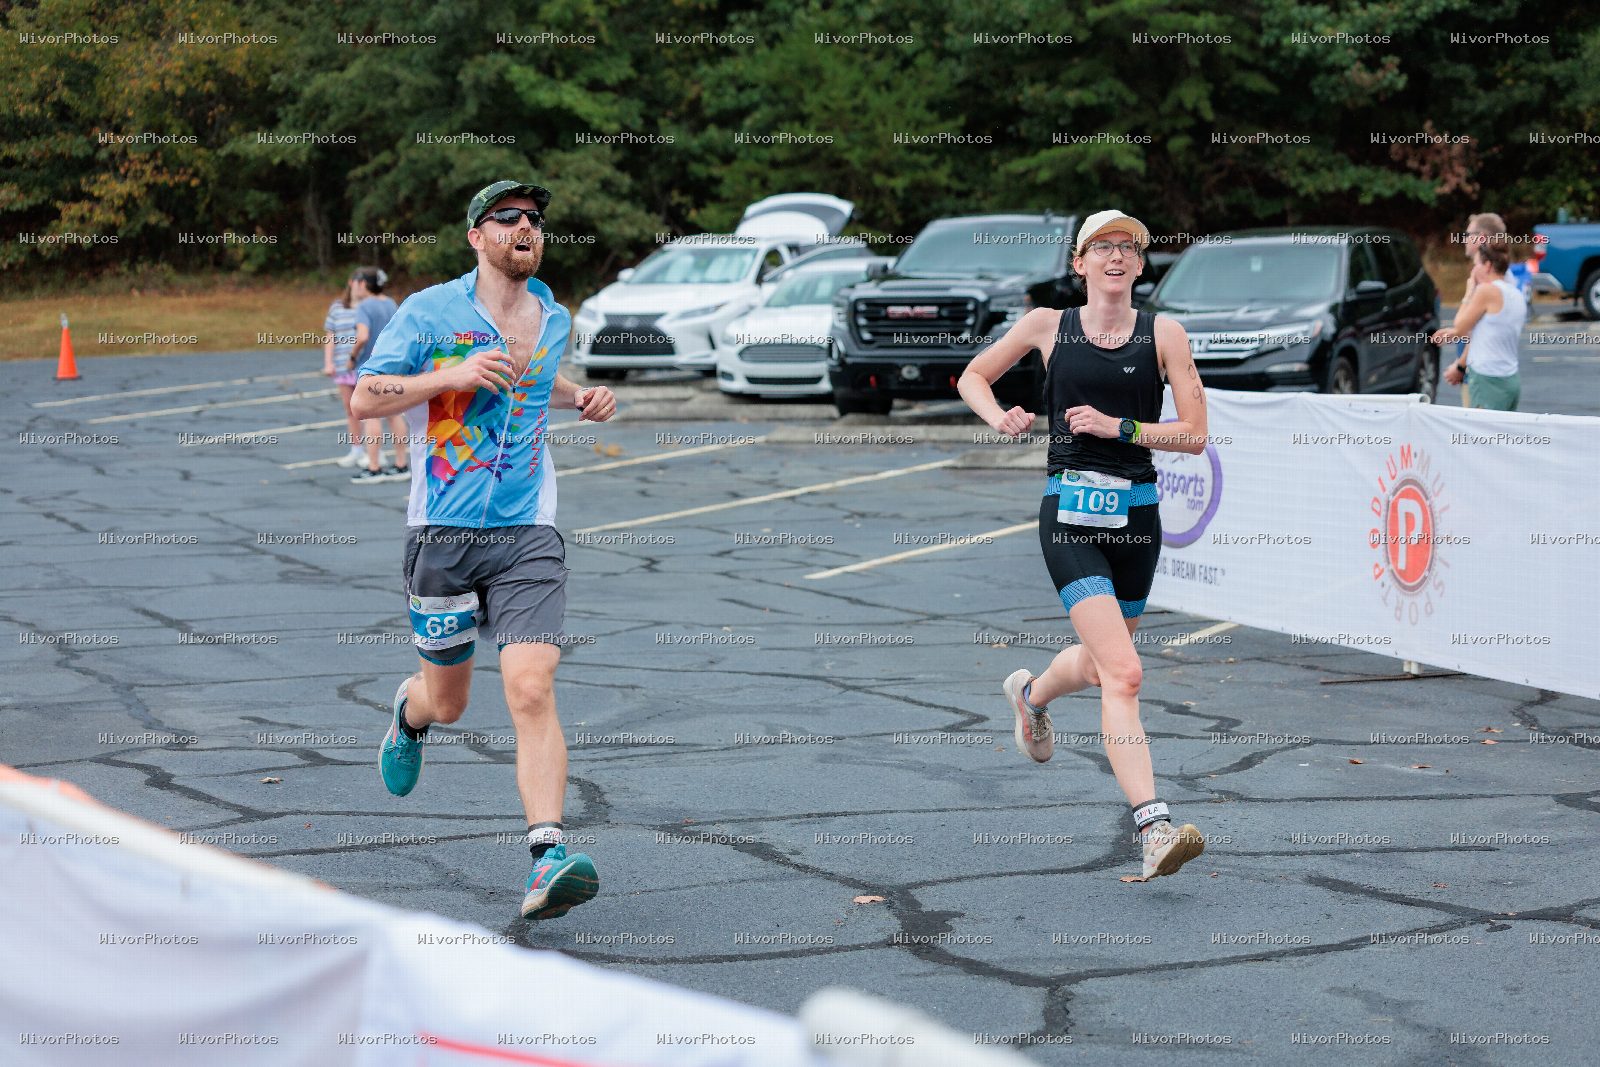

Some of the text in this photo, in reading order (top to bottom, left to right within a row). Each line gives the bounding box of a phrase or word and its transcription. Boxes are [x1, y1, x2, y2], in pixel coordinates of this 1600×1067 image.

[1073, 488, 1119, 513] 109
[1397, 497, 1424, 571] P
[1172, 558, 1196, 582] DREAM
[425, 615, 459, 637] 68
